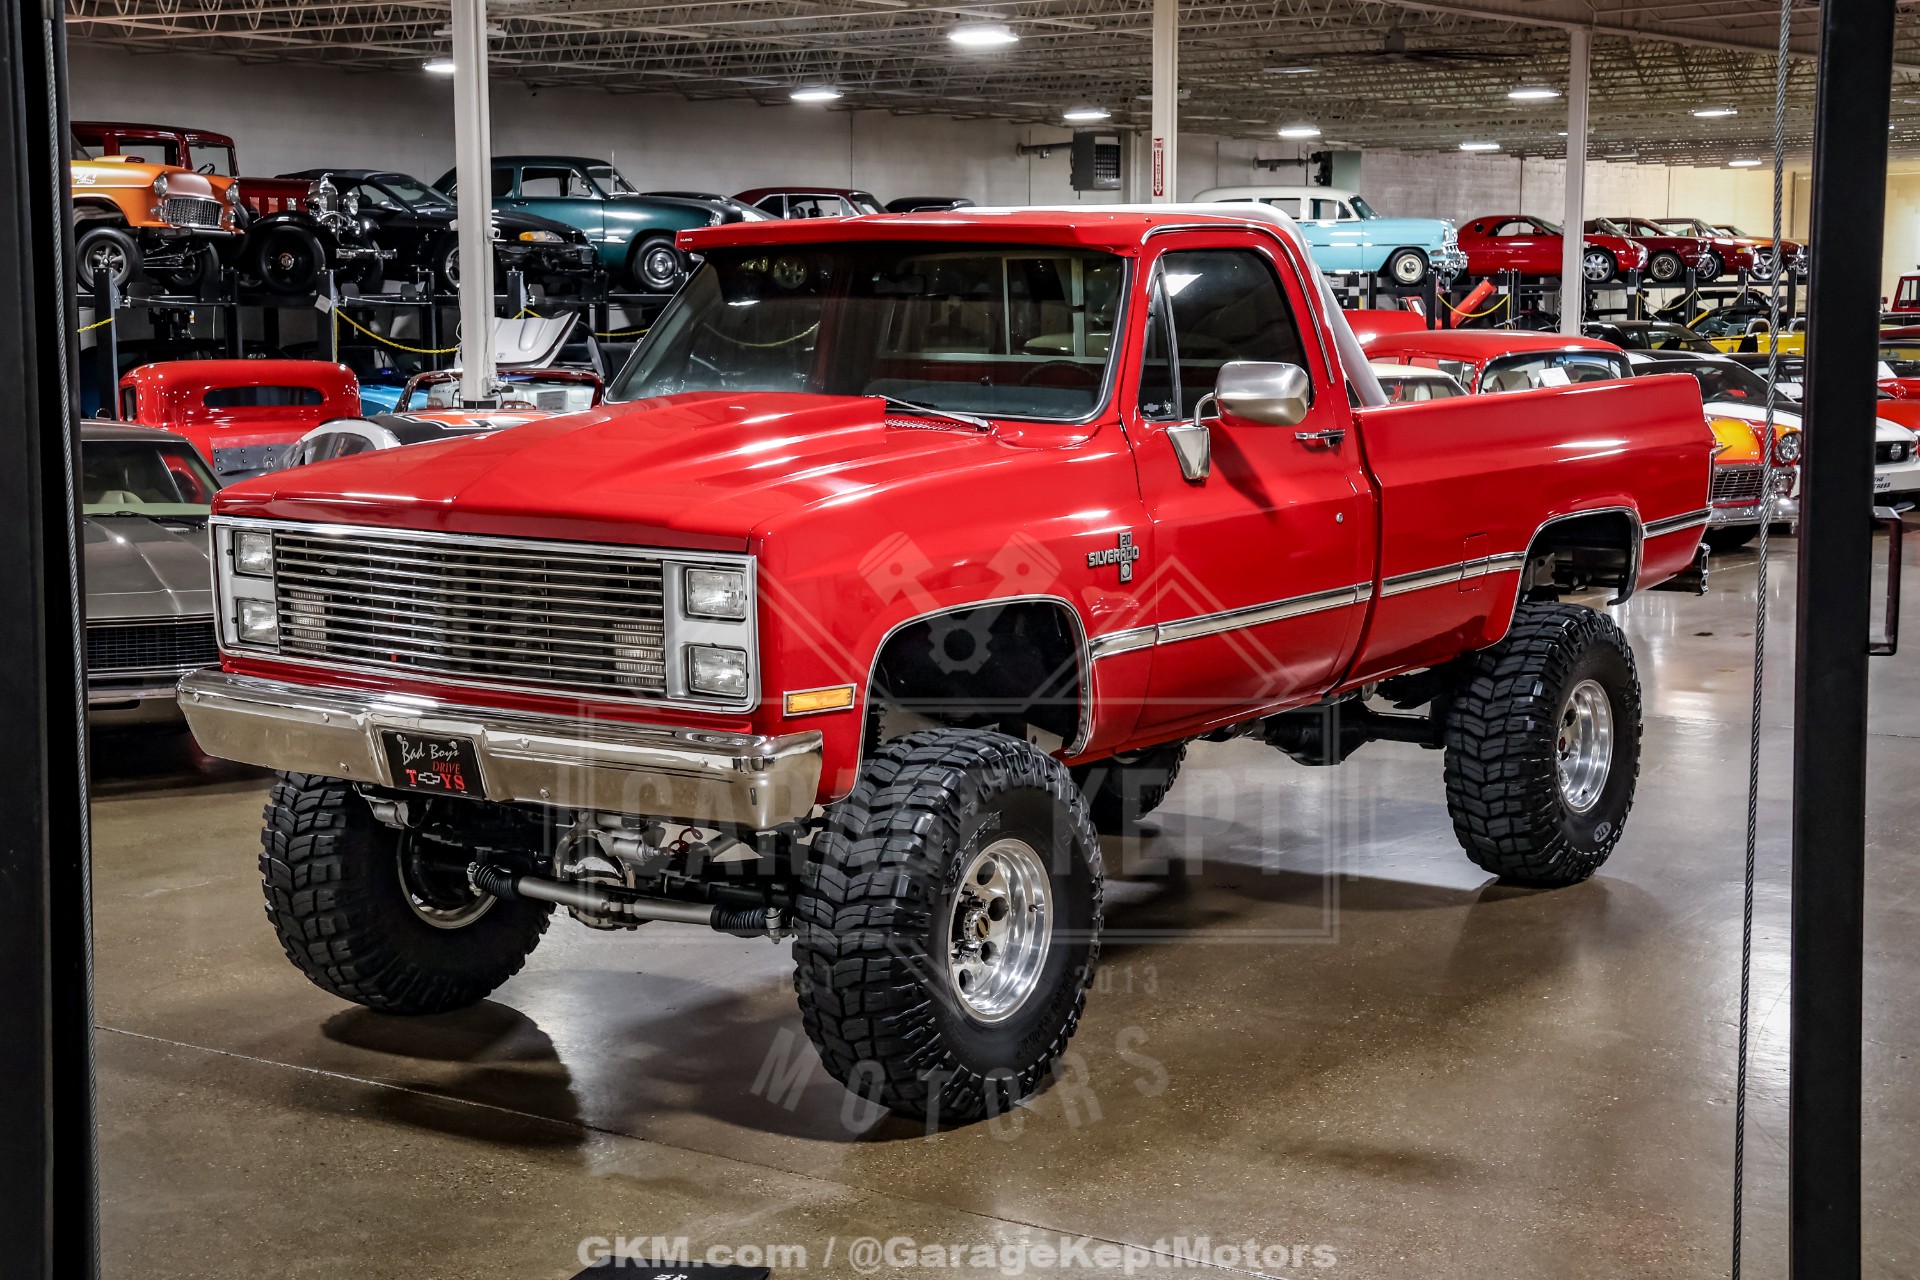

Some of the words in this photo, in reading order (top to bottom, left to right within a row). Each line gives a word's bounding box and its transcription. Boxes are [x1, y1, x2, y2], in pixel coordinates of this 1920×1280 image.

[1121, 534, 1131, 546] 20
[1088, 546, 1140, 567] SILVERADO
[401, 740, 426, 766] Bad
[429, 744, 460, 762] Boys
[432, 761, 461, 775] DRIVE
